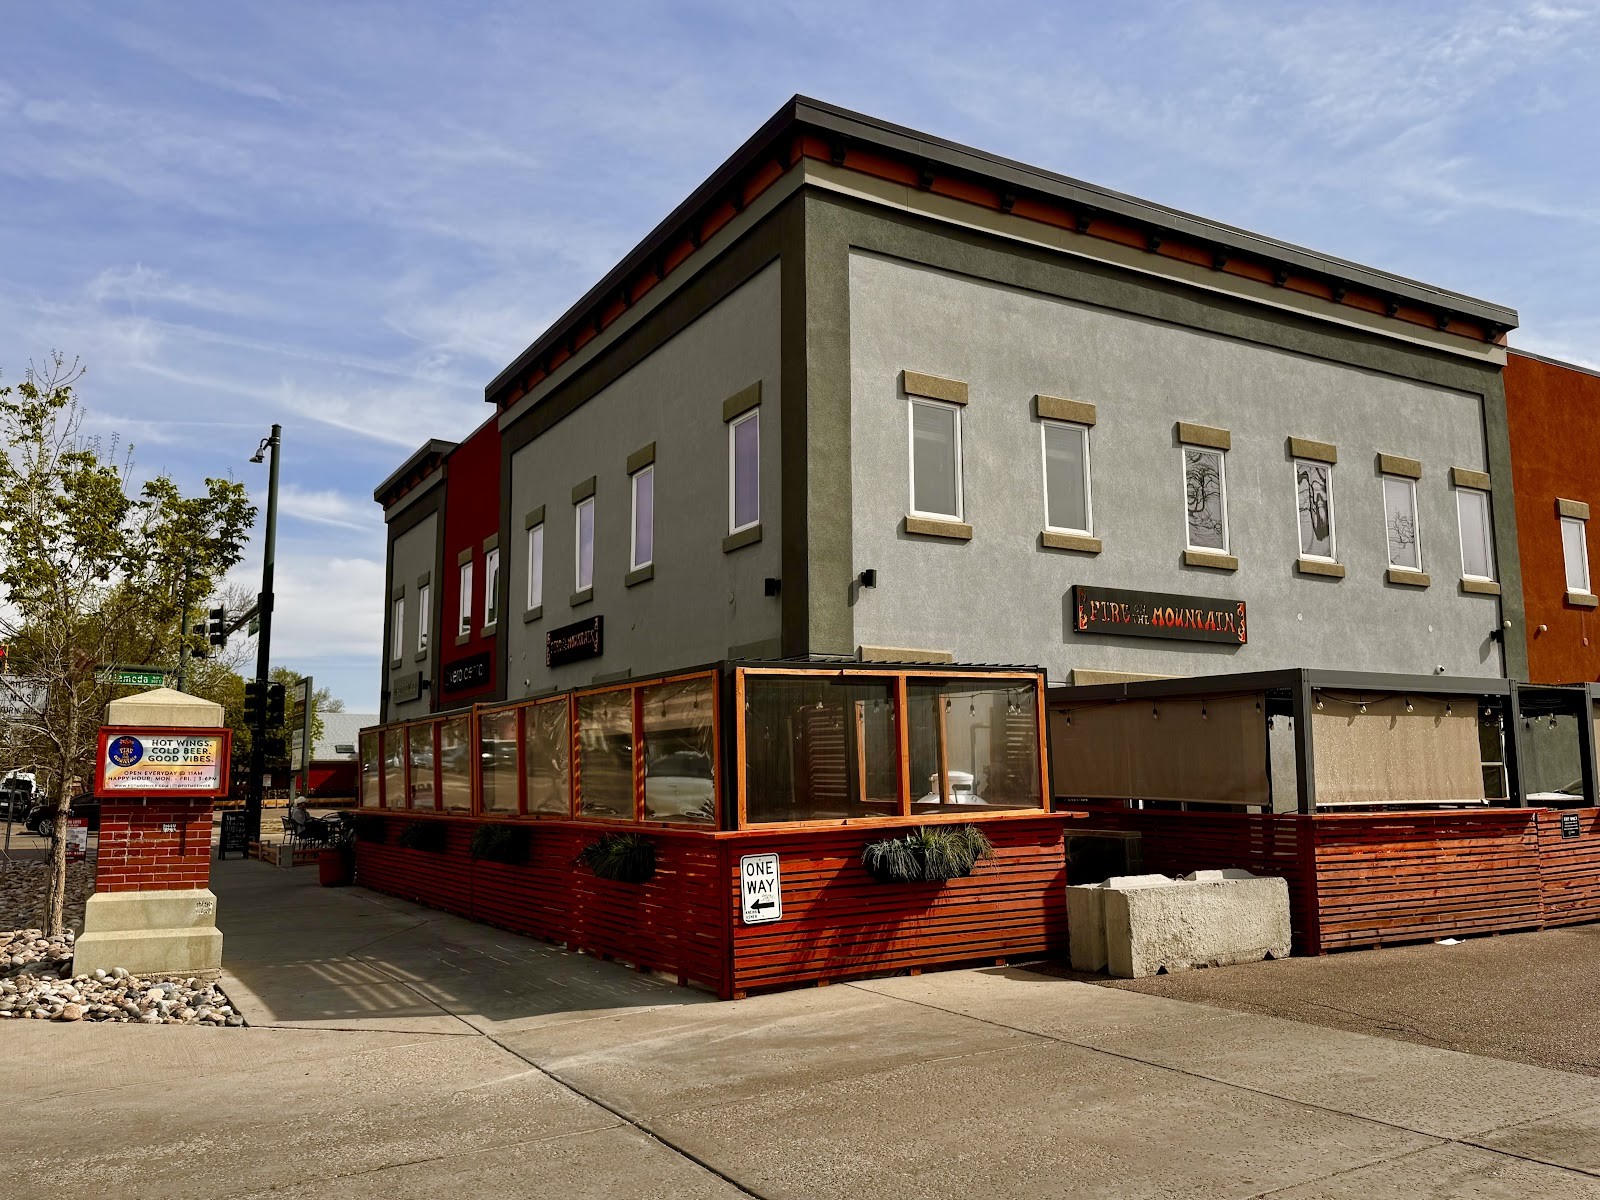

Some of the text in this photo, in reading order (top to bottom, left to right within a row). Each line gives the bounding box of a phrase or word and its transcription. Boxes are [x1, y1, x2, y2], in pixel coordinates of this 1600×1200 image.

[1090, 600, 1236, 633] FIRE ON THE MOUNTAIN
[151, 739, 212, 747] HOT WINGS.
[151, 747, 212, 755] COLD BEER.
[746, 861, 774, 876] ONE
[746, 879, 774, 894] WAY
